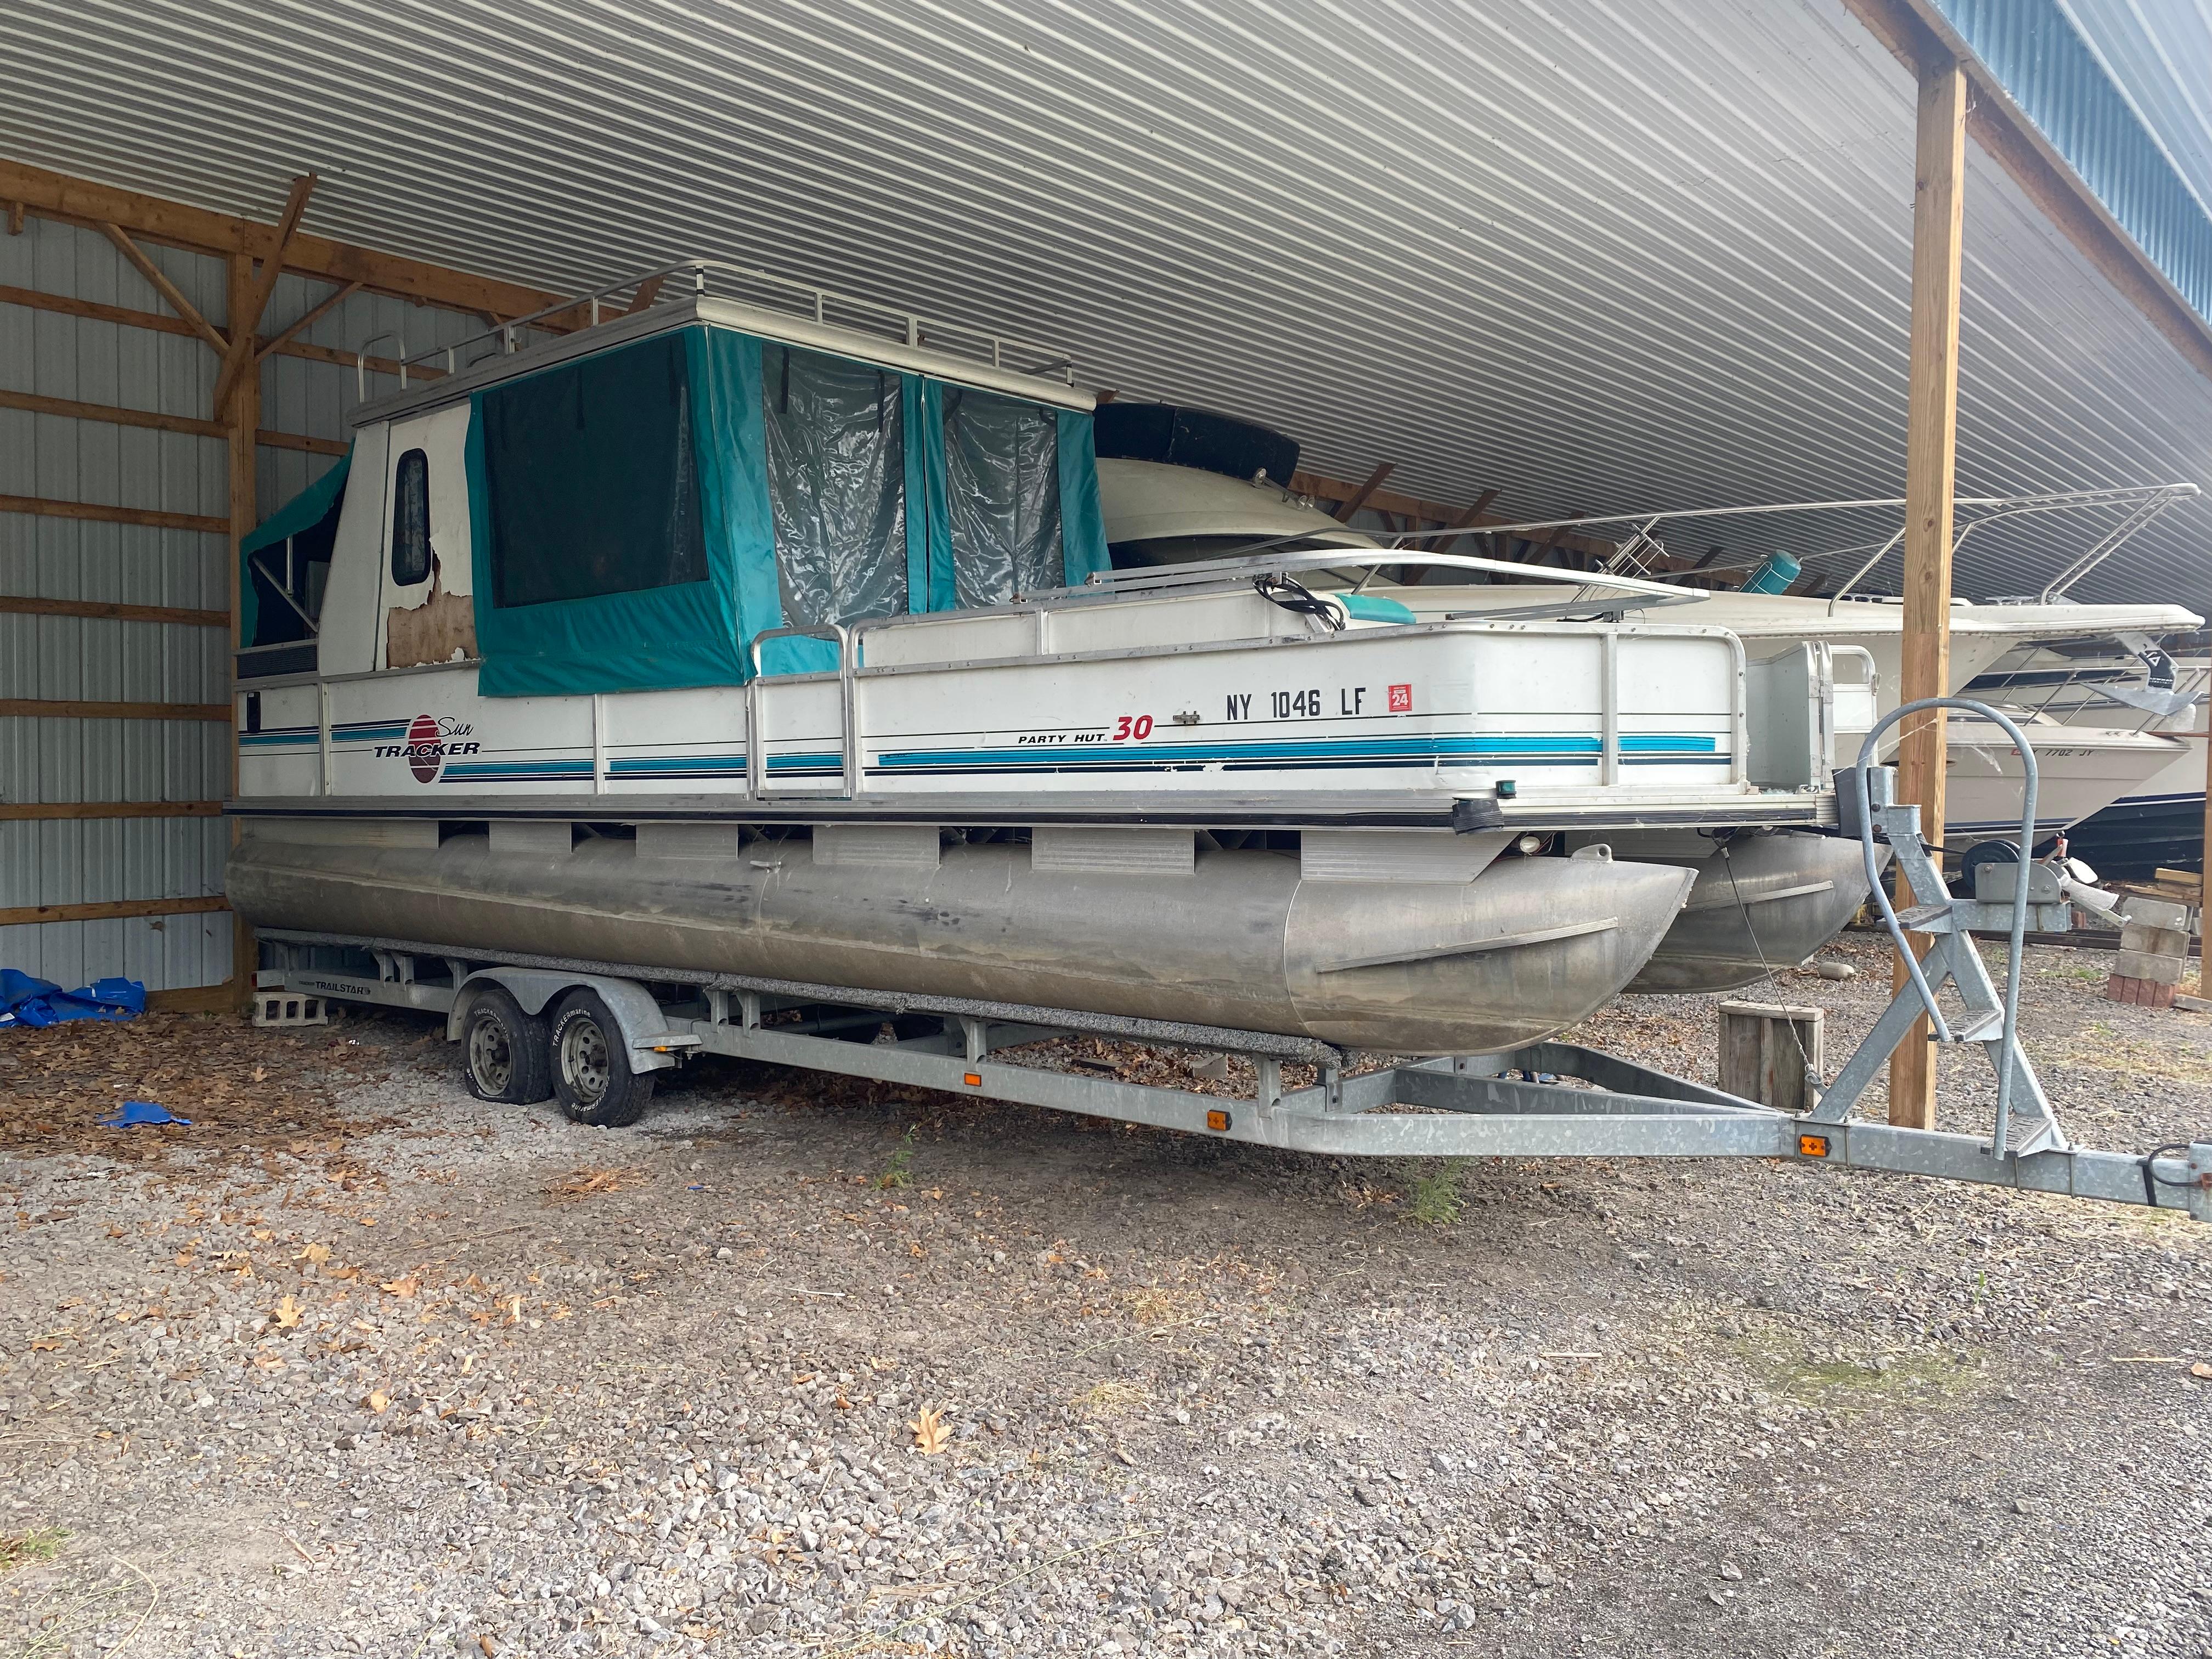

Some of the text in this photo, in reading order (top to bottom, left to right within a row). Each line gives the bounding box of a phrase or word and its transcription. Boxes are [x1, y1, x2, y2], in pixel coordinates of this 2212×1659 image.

[1227, 687, 1366, 720] NY 1046 LF
[1392, 693, 1408, 706] 24
[436, 716, 474, 737] Sun
[1018, 715, 1153, 744] PARTY HUT 30
[374, 742, 481, 758] TRACKER
[315, 981, 364, 995] TRAILSTAR
